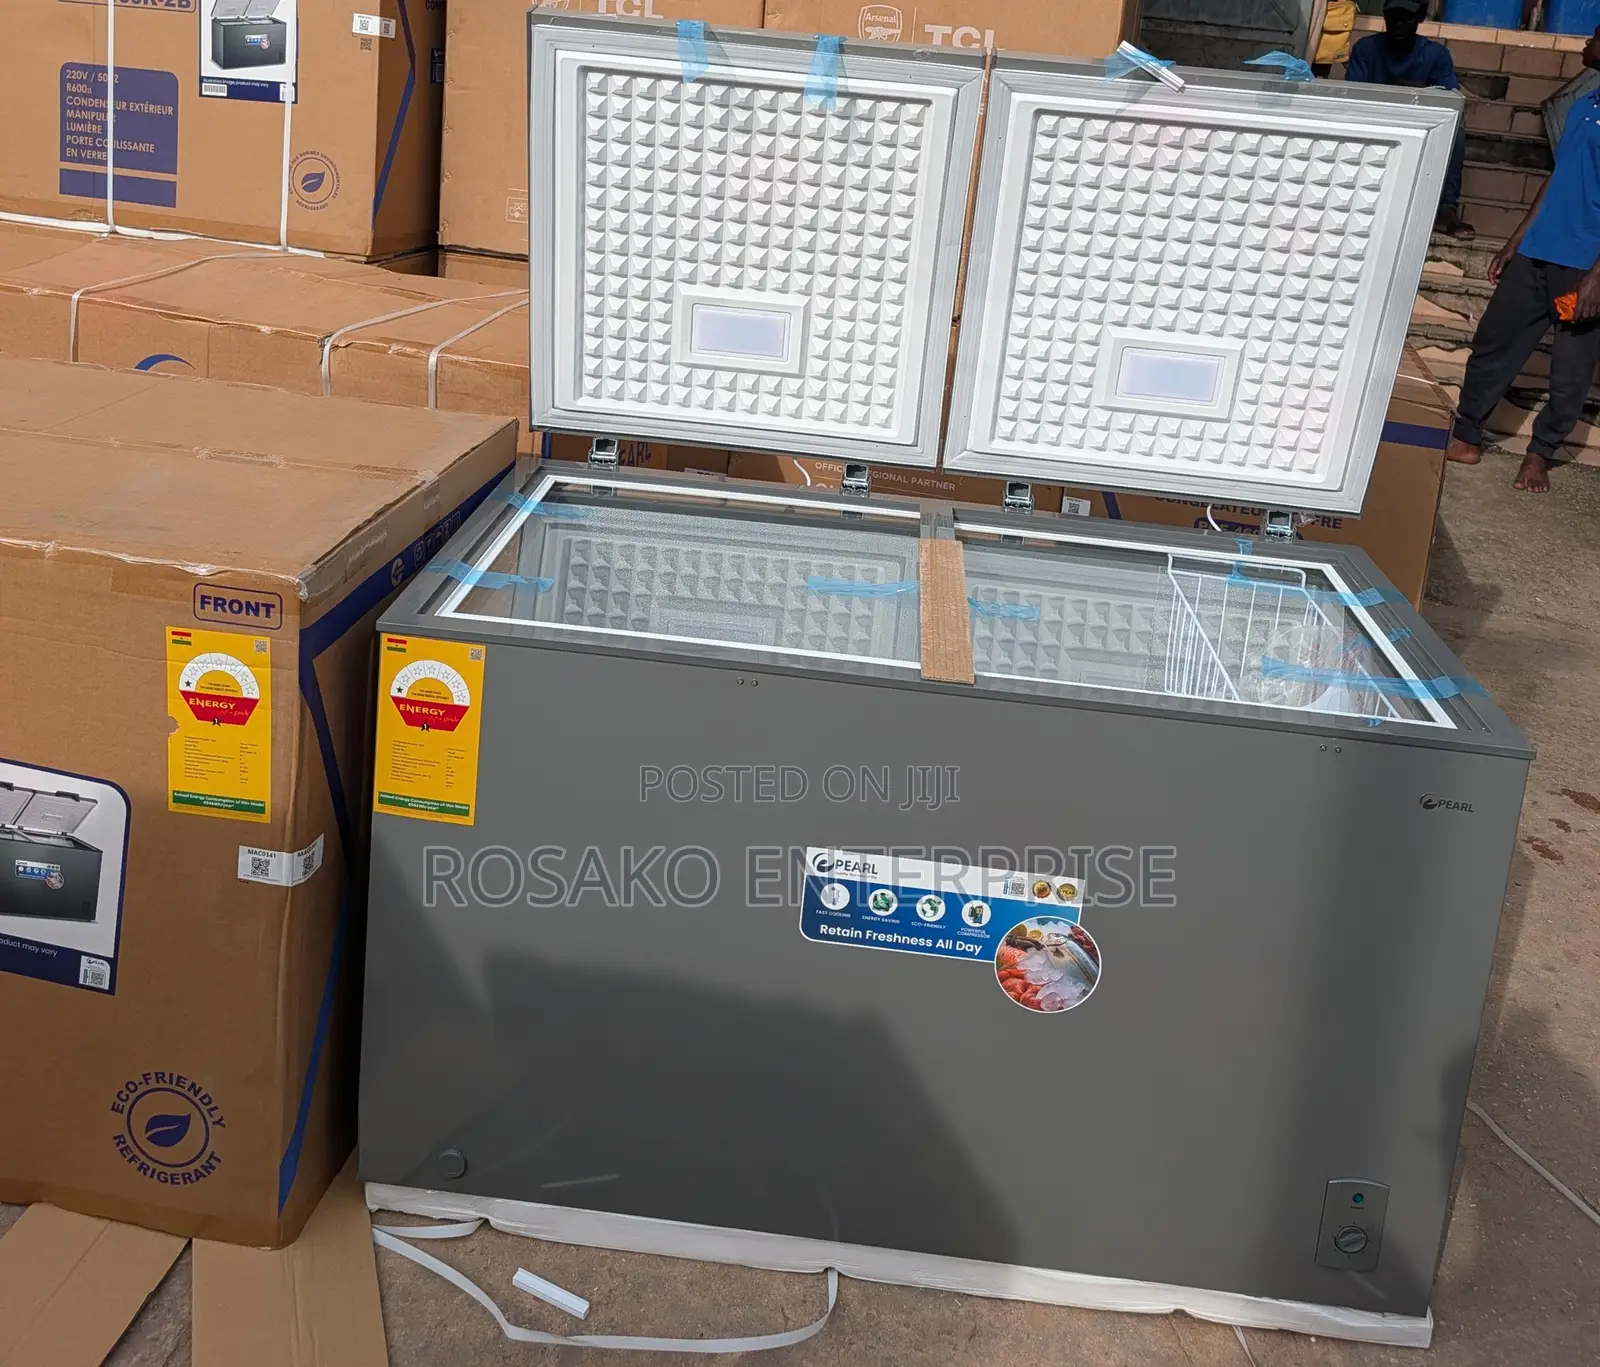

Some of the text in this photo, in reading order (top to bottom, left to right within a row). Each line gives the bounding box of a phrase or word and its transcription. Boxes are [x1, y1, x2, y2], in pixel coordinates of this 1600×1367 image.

[598, 0, 664, 19] TCL
[864, 12, 898, 23] Arsenal
[924, 24, 1007, 52] TCL
[66, 69, 88, 80] 220V
[97, 73, 120, 84] 50Z
[66, 95, 174, 116] CONDENUR EXTÉRIEUR
[66, 109, 117, 123] MANIPUL
[66, 121, 103, 134] LUMIÈRE
[66, 134, 94, 147] PORTE
[66, 147, 108, 161] EN VERRE
[911, 477, 956, 491] PARTNER
[200, 594, 276, 618] FRONT
[189, 697, 236, 710] ENERGY
[400, 703, 446, 716] ENERGY
[1437, 799, 1474, 813] PEARL
[247, 848, 276, 858] MAC0341
[835, 859, 878, 875] PEARL
[911, 921, 946, 929] ECO-FRIENDLY
[820, 924, 983, 956] Retain Freshness All Day
[957, 931, 991, 939] COMPRESSOR
[22, 943, 39, 953] may
[41, 946, 58, 957] vary
[111, 1071, 226, 1128] ECO-FRIENDLY
[113, 1134, 222, 1186] REFRIGERANT
